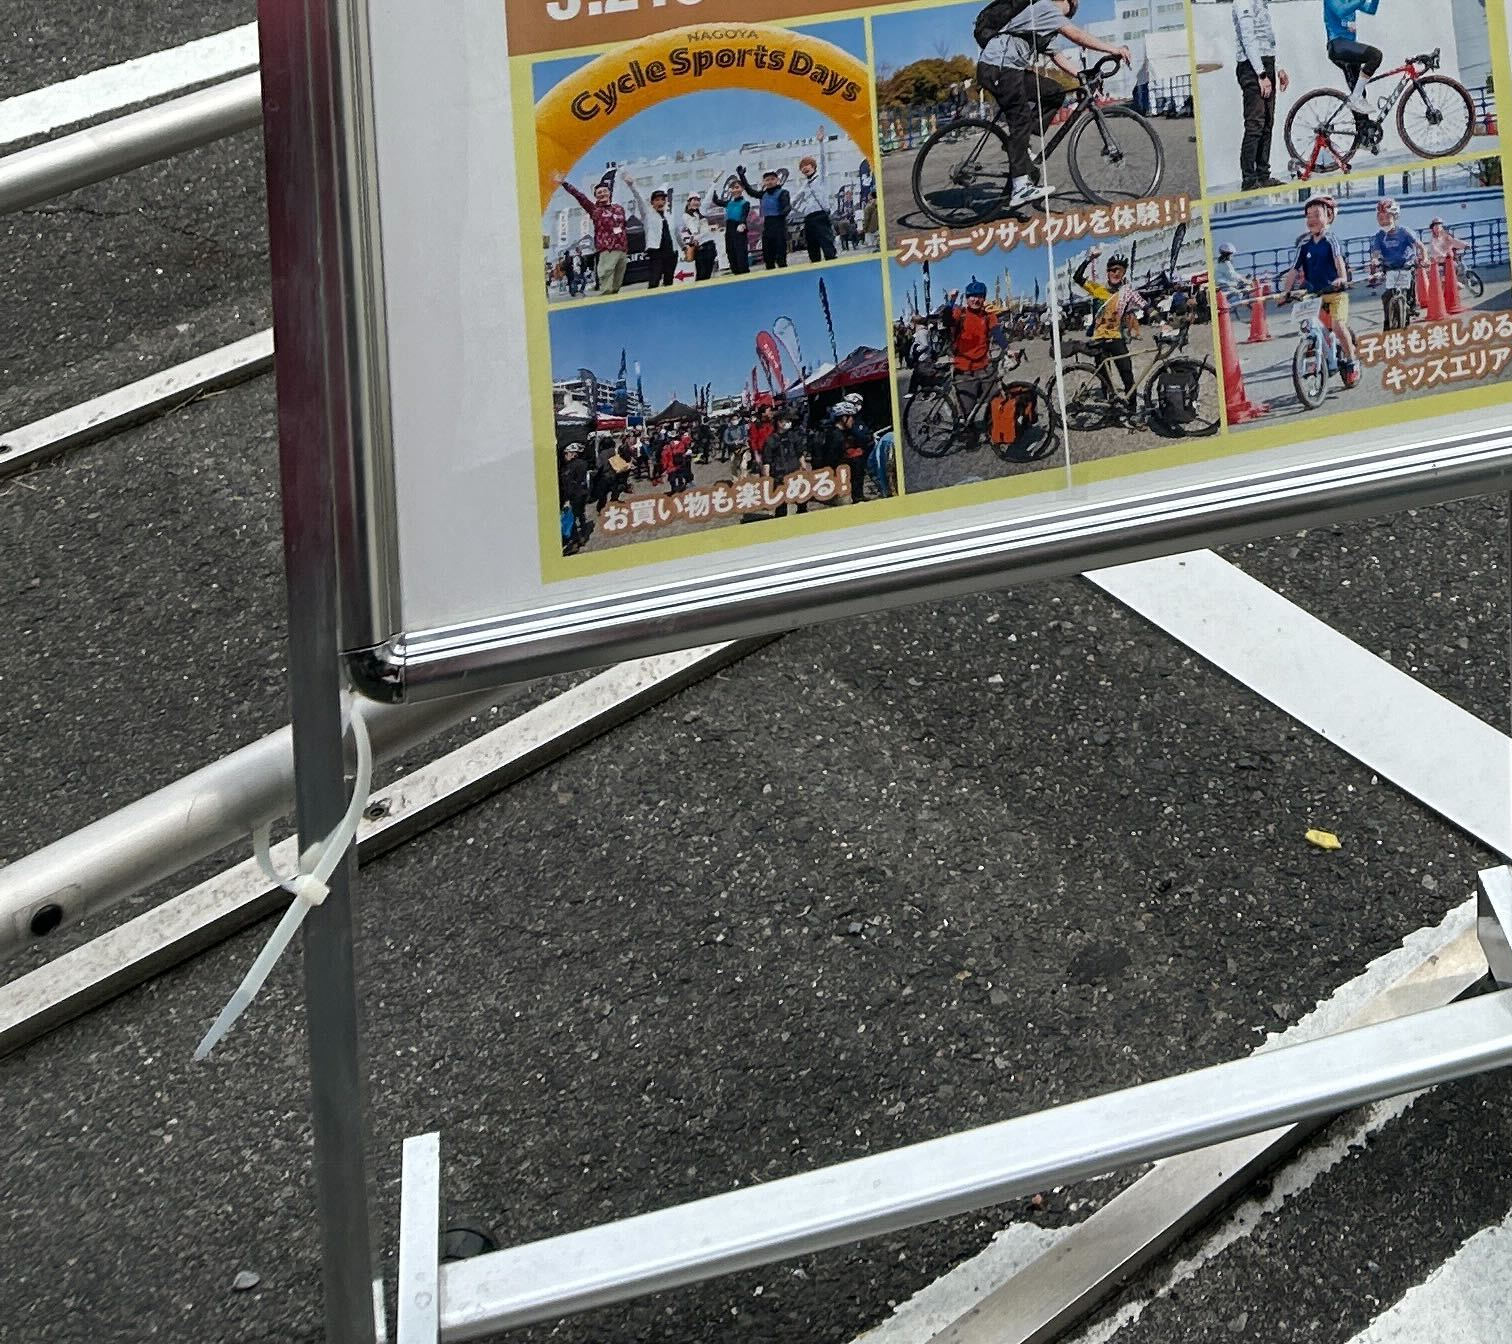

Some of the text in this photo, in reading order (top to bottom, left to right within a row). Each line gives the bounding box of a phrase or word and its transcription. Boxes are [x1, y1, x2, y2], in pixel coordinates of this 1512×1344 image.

[687, 27, 760, 44] NAGOYA
[571, 44, 862, 121] Cycle Sports Days
[1385, 348, 1511, 389] キッズエリア
[603, 468, 849, 531] お買い物も楽しめる!
